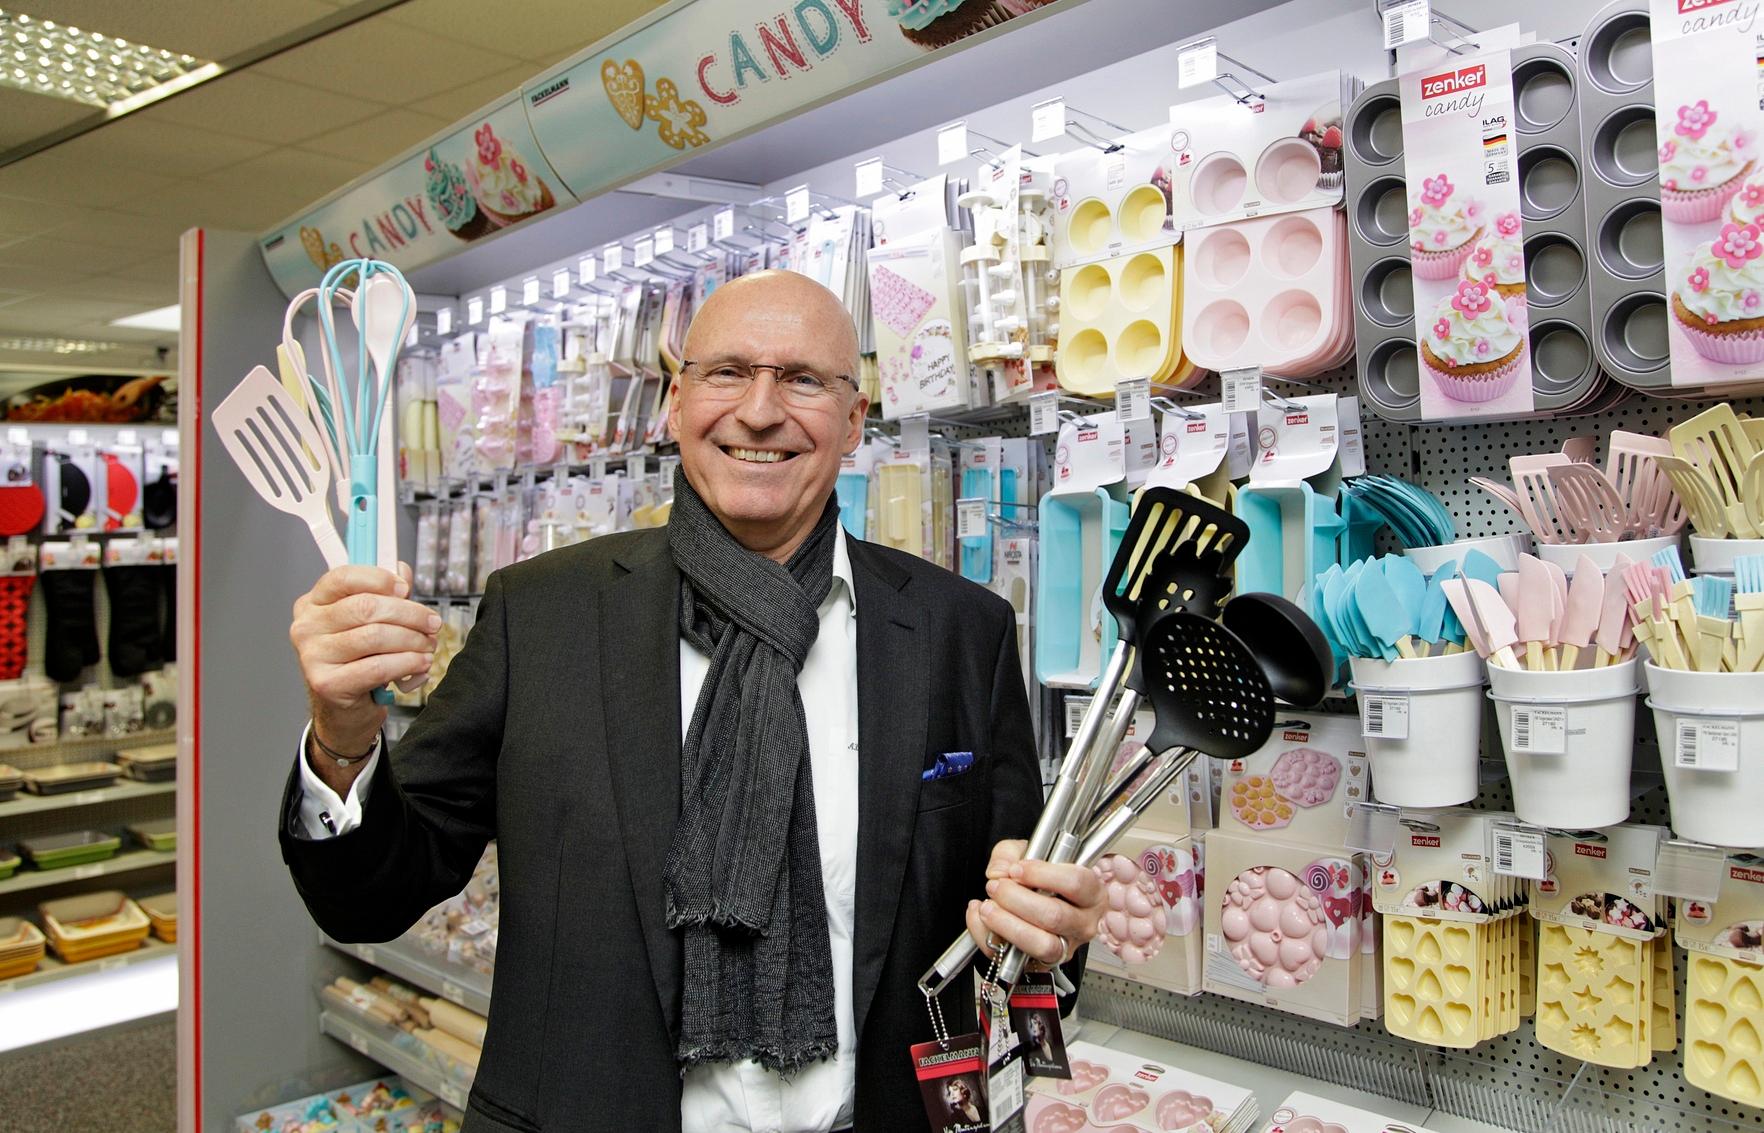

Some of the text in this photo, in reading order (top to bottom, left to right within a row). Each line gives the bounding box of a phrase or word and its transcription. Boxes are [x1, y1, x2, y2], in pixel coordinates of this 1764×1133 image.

[1681, 1, 1760, 34] candy
[696, 0, 872, 105] CANDY
[1423, 67, 1484, 97] zenker
[1425, 92, 1485, 119] candy
[1482, 115, 1505, 126] ILAG
[1488, 162, 1495, 174] 5
[350, 194, 435, 261] CANDY
[928, 353, 950, 371] HAPPY
[920, 364, 955, 389] BIRTHDAY
[1412, 837, 1440, 847] zenker
[1575, 844, 1606, 858] zenker
[919, 1047, 980, 1066] FACKELMANN
